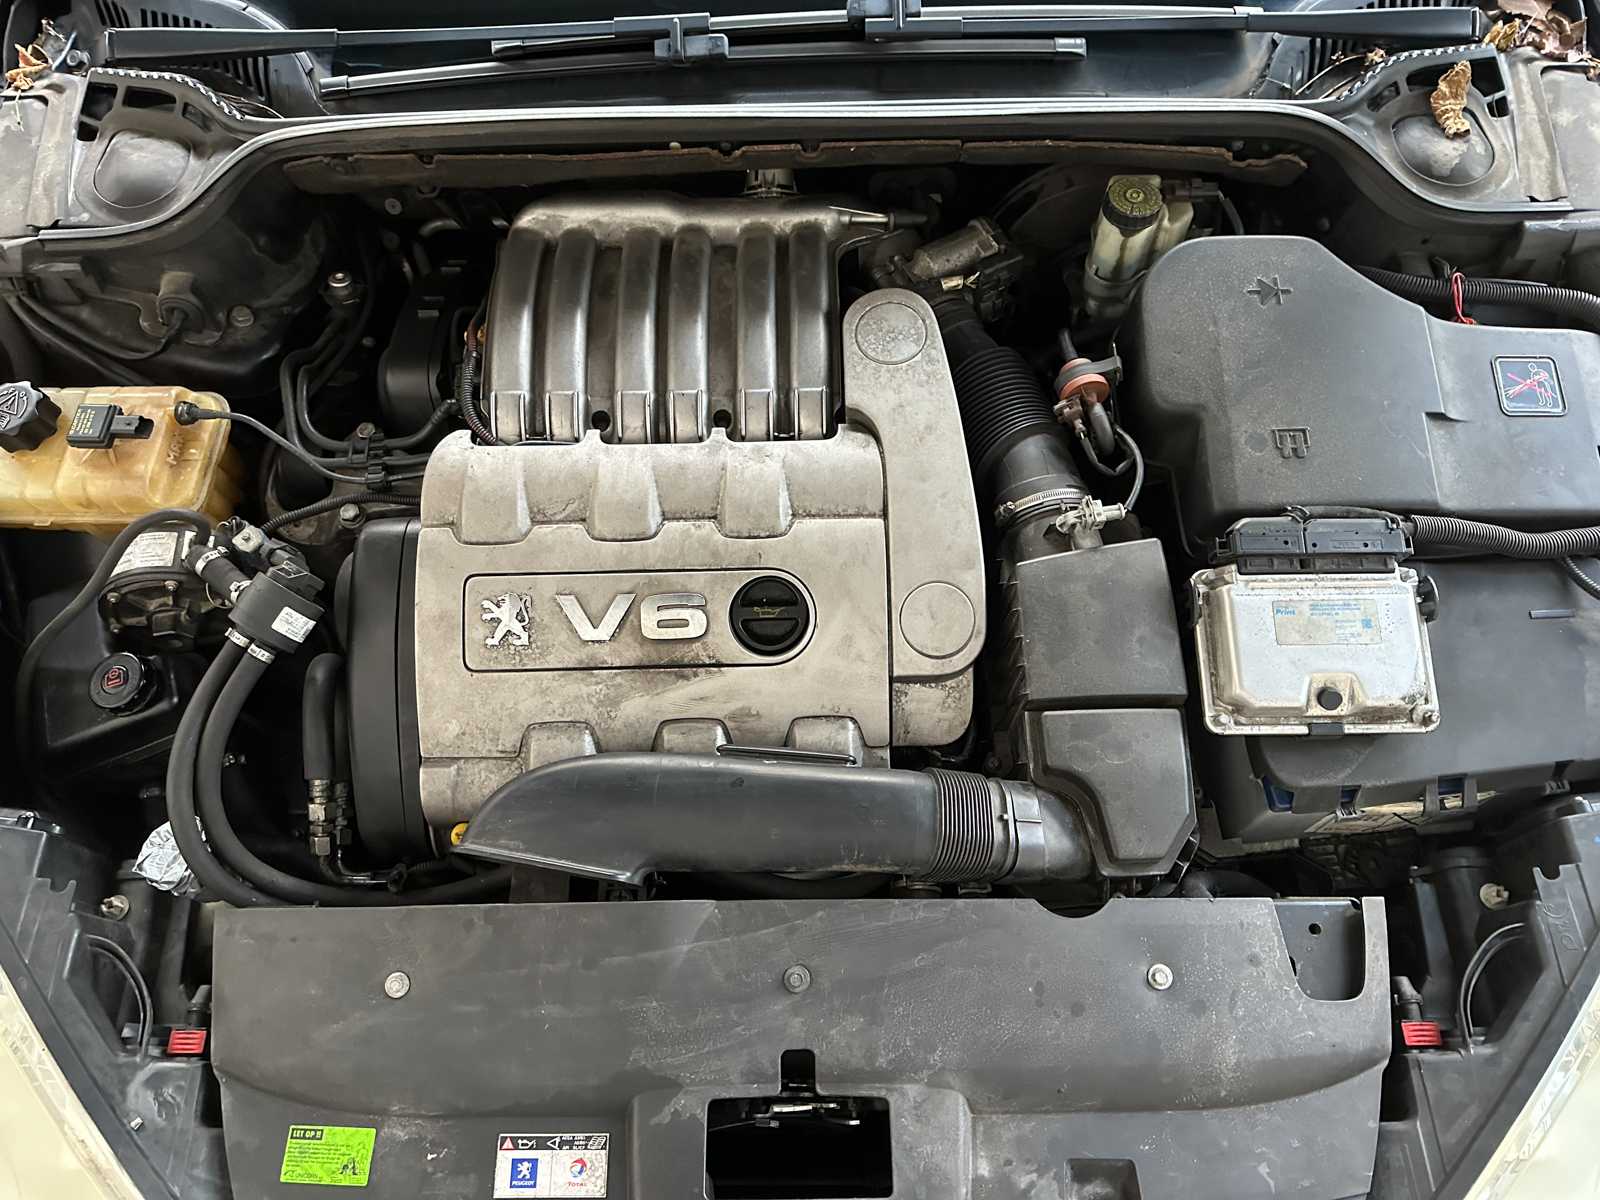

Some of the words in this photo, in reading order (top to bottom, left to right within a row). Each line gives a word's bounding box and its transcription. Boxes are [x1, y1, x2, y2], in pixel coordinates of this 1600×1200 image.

[556, 593, 707, 641] V6
[293, 1130, 304, 1138] LET
[305, 1130, 315, 1138] OP
